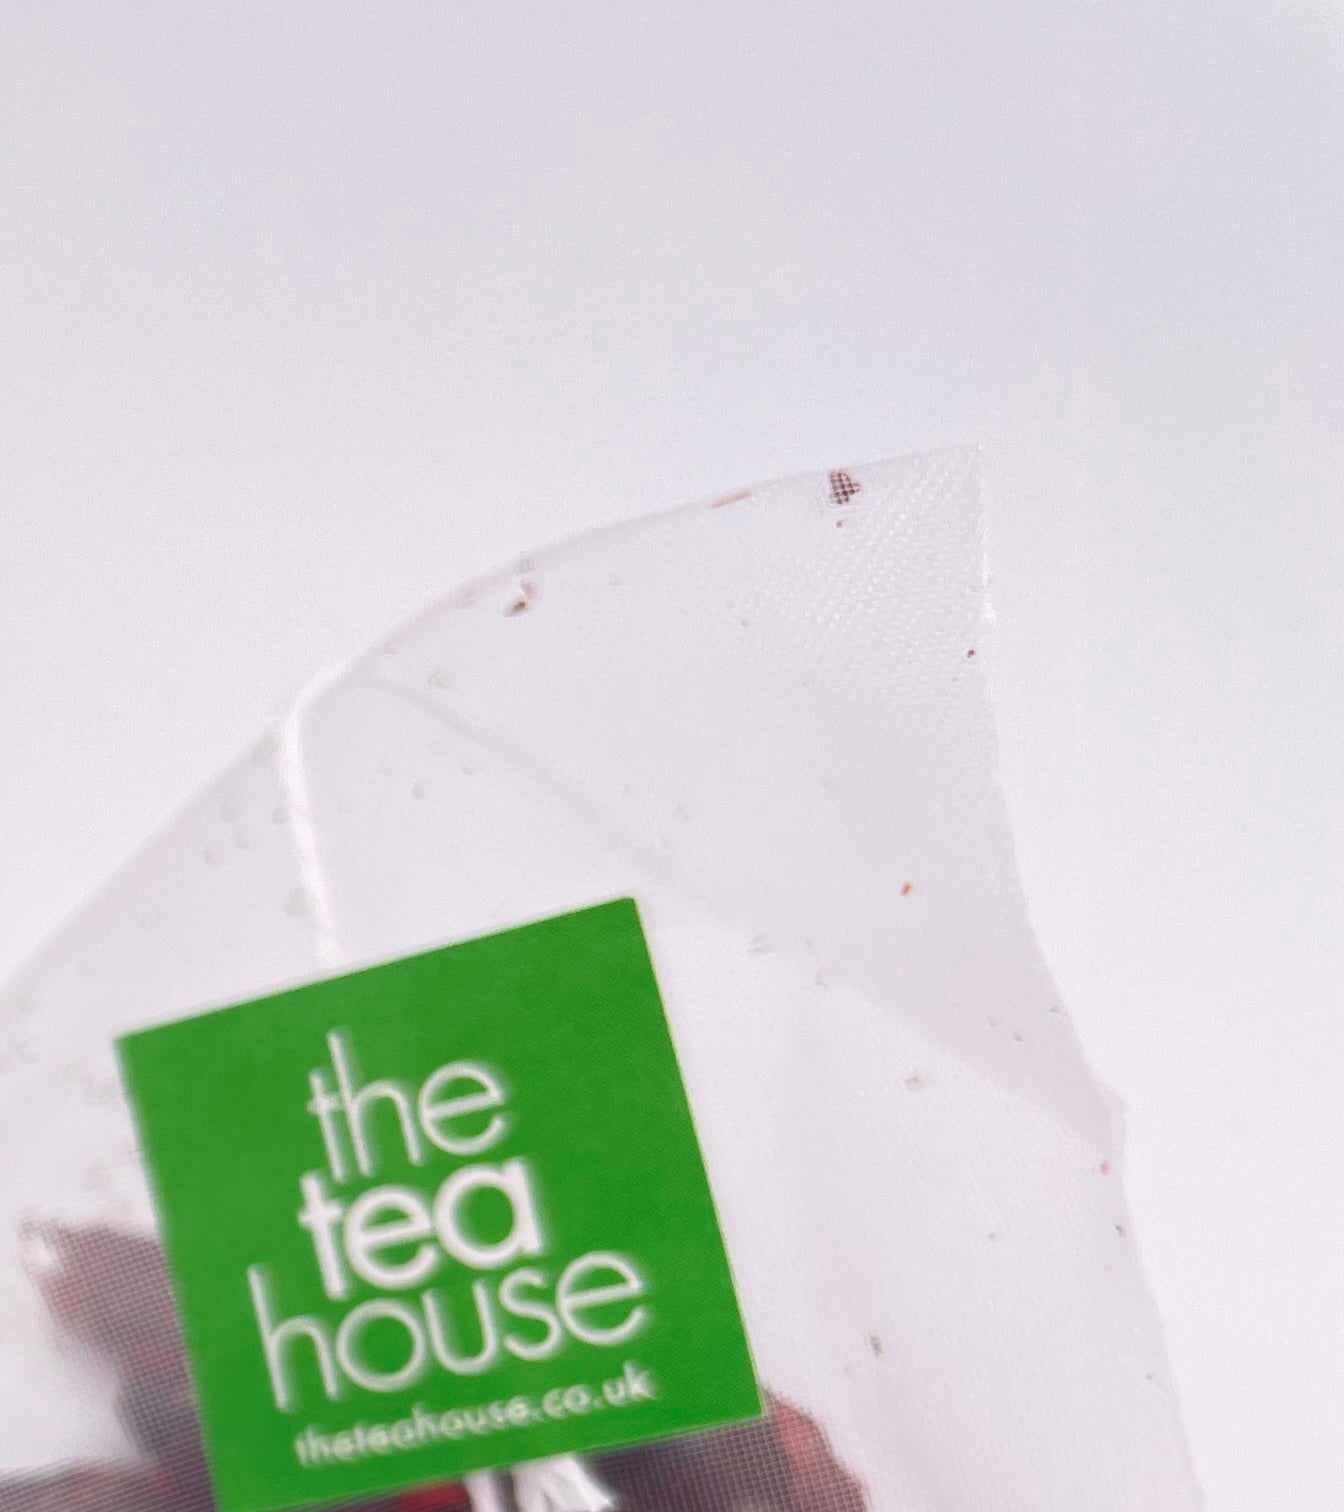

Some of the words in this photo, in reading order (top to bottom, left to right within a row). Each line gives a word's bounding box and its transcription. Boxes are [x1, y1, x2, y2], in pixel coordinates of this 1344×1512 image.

[306, 1030, 508, 1185] the
[297, 1157, 547, 1300] tea
[247, 1250, 648, 1411] house
[294, 1362, 654, 1467] theteahouse.co.uk
